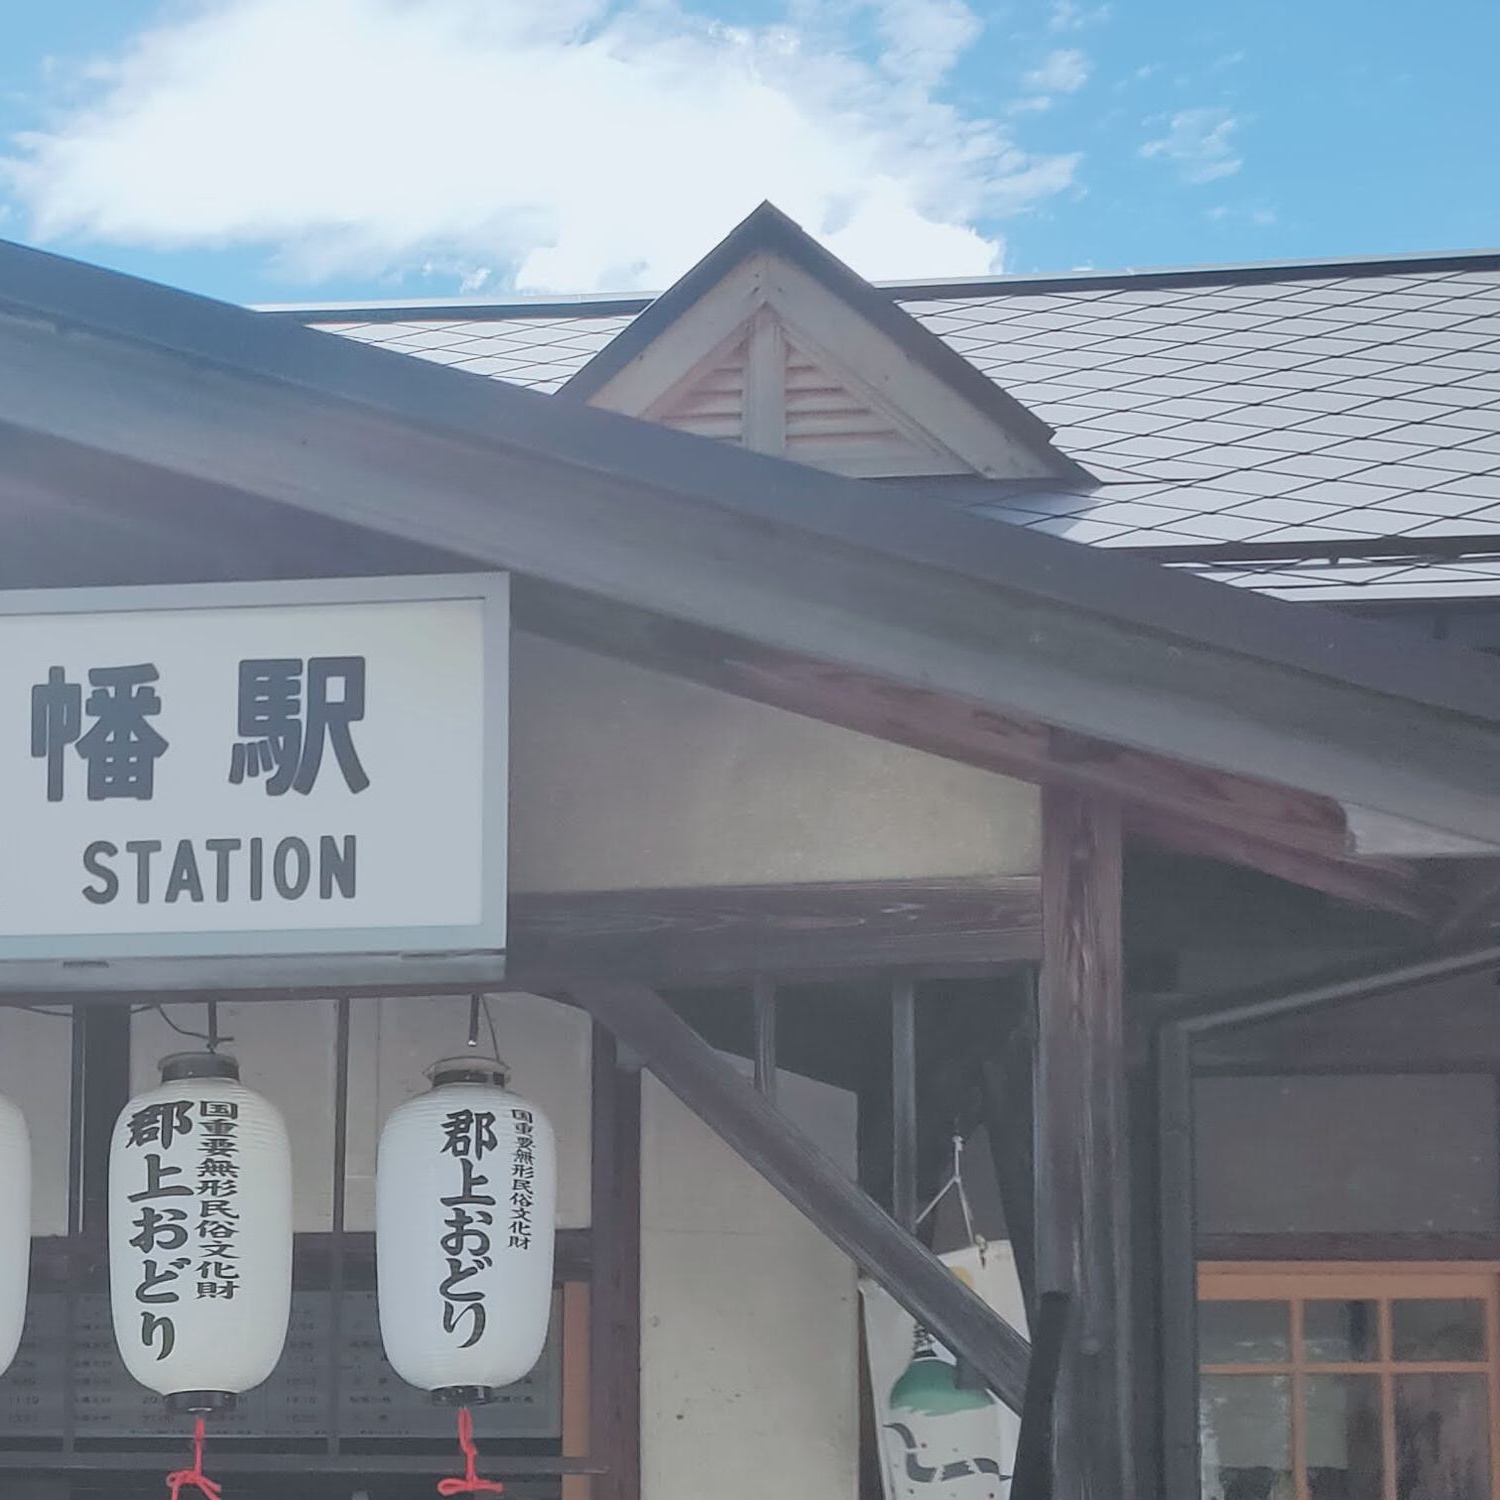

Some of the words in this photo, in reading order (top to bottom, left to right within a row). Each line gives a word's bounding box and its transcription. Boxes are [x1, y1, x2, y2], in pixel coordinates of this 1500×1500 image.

[81, 835, 358, 905] STATION
[124, 1099, 194, 1361] 郡上おどり
[439, 1109, 498, 1349] 郡上おどり
